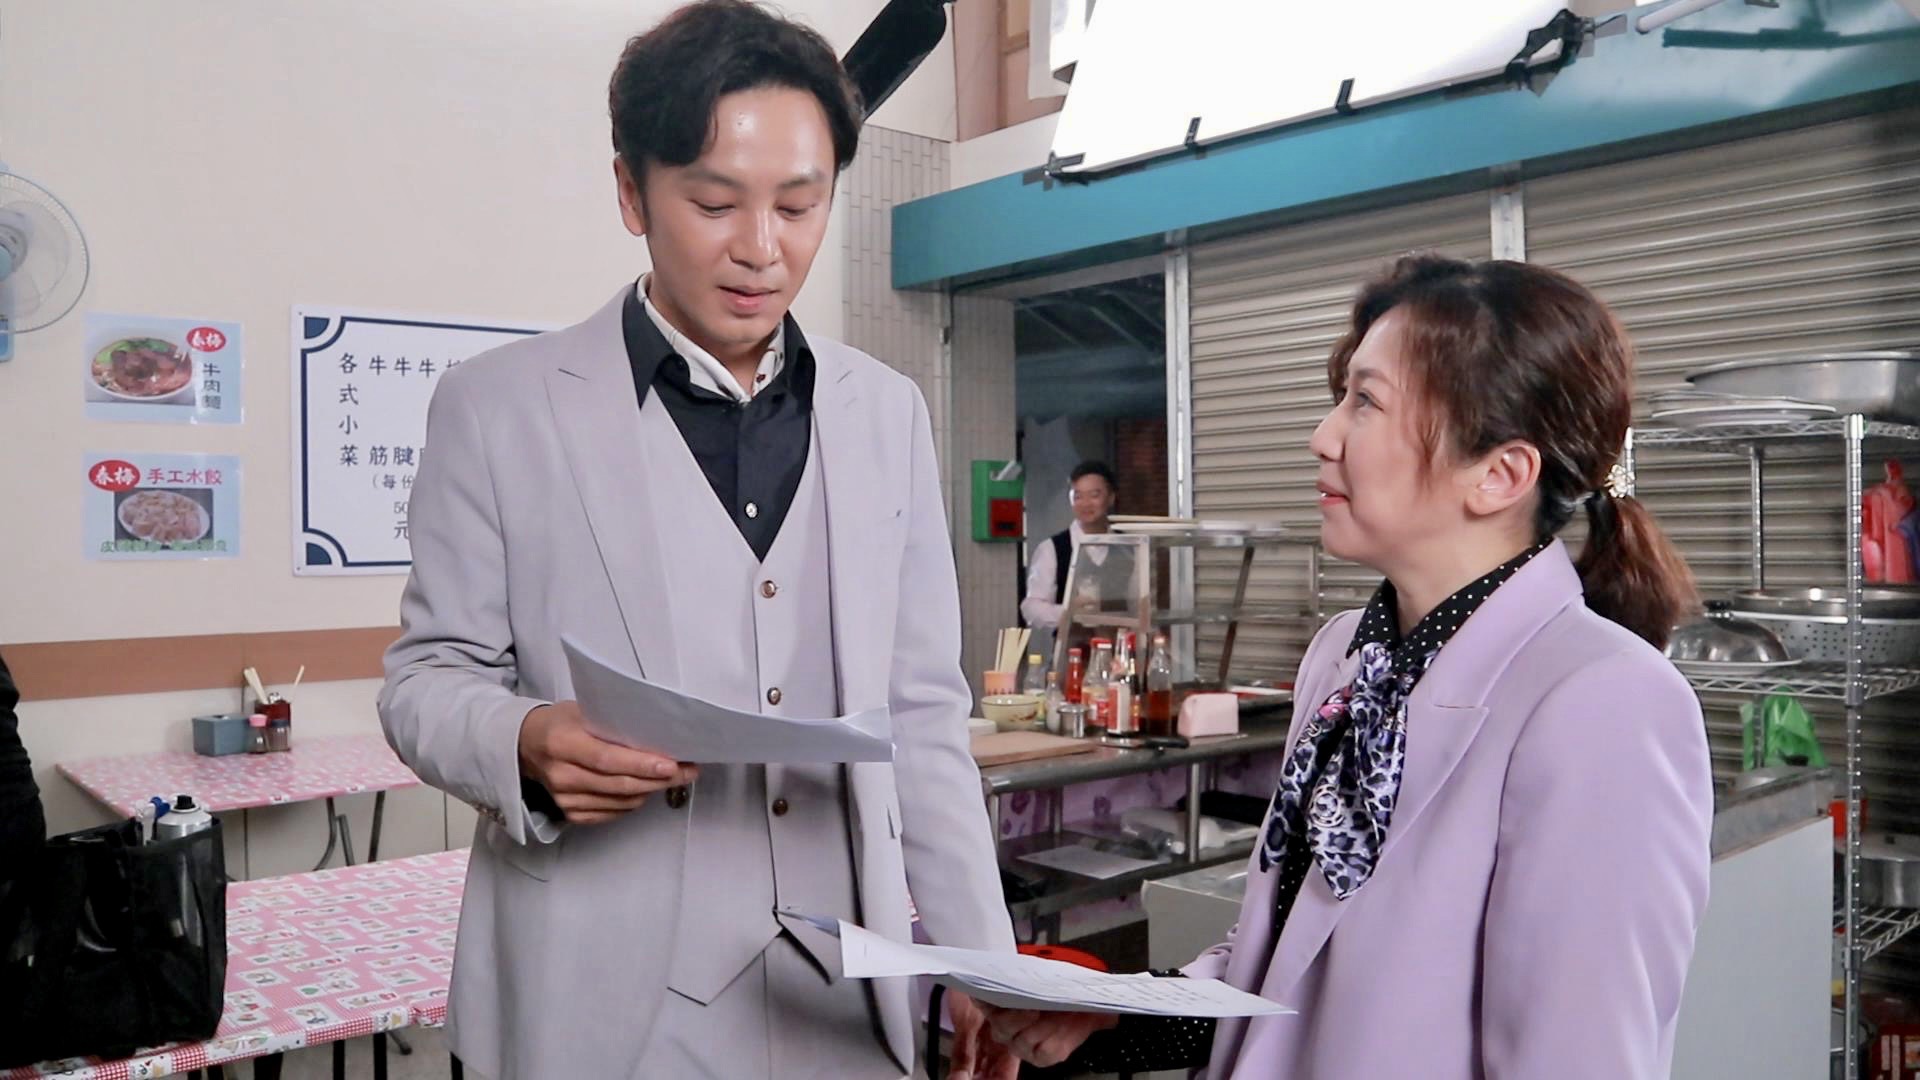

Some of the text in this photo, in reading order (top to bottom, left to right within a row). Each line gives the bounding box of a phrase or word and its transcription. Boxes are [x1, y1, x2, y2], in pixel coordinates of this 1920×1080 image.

[339, 352, 359, 467] 各式小菜
[147, 468, 223, 485] 手工水餃
